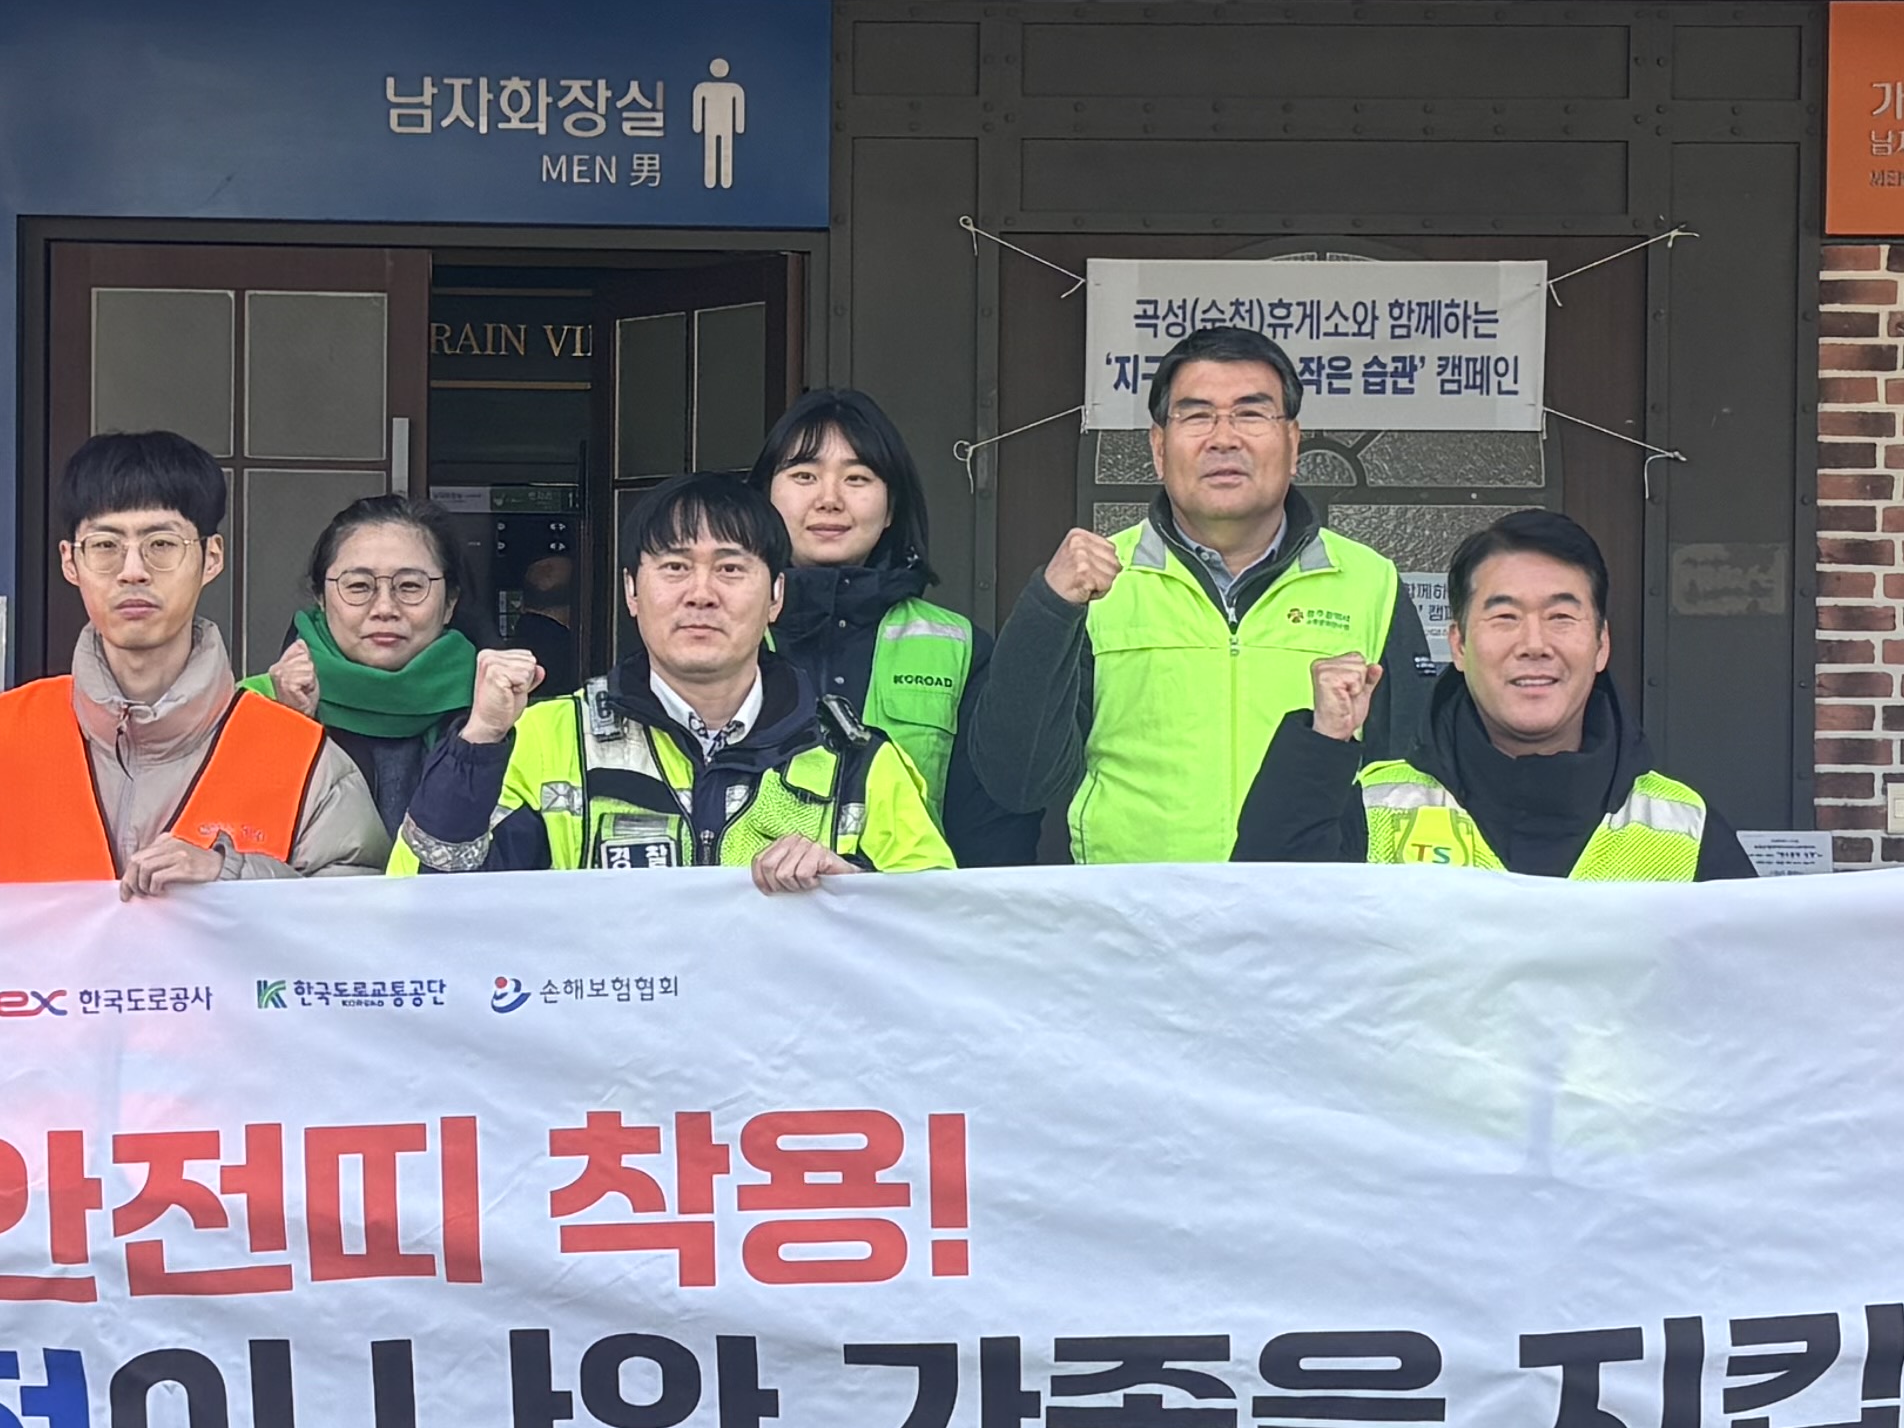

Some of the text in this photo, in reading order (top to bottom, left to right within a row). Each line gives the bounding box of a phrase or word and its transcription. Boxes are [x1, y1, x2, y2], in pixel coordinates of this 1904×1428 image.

[386, 76, 666, 138] 남자화장실
[541, 153, 663, 188] MEN 男
[1133, 297, 1500, 341] 곡성(순천)휴게소와 함께하는
[1299, 354, 1353, 395] 작은
[1435, 354, 1521, 396] 캠페인
[893, 674, 953, 688] KOROAD
[1411, 843, 1452, 865] TS
[78, 986, 214, 1015] 한국도로공사
[293, 978, 448, 1009] 한국도로교통공단
[539, 975, 680, 1004] 손해보험협회
[549, 1108, 970, 1287] 착용!
